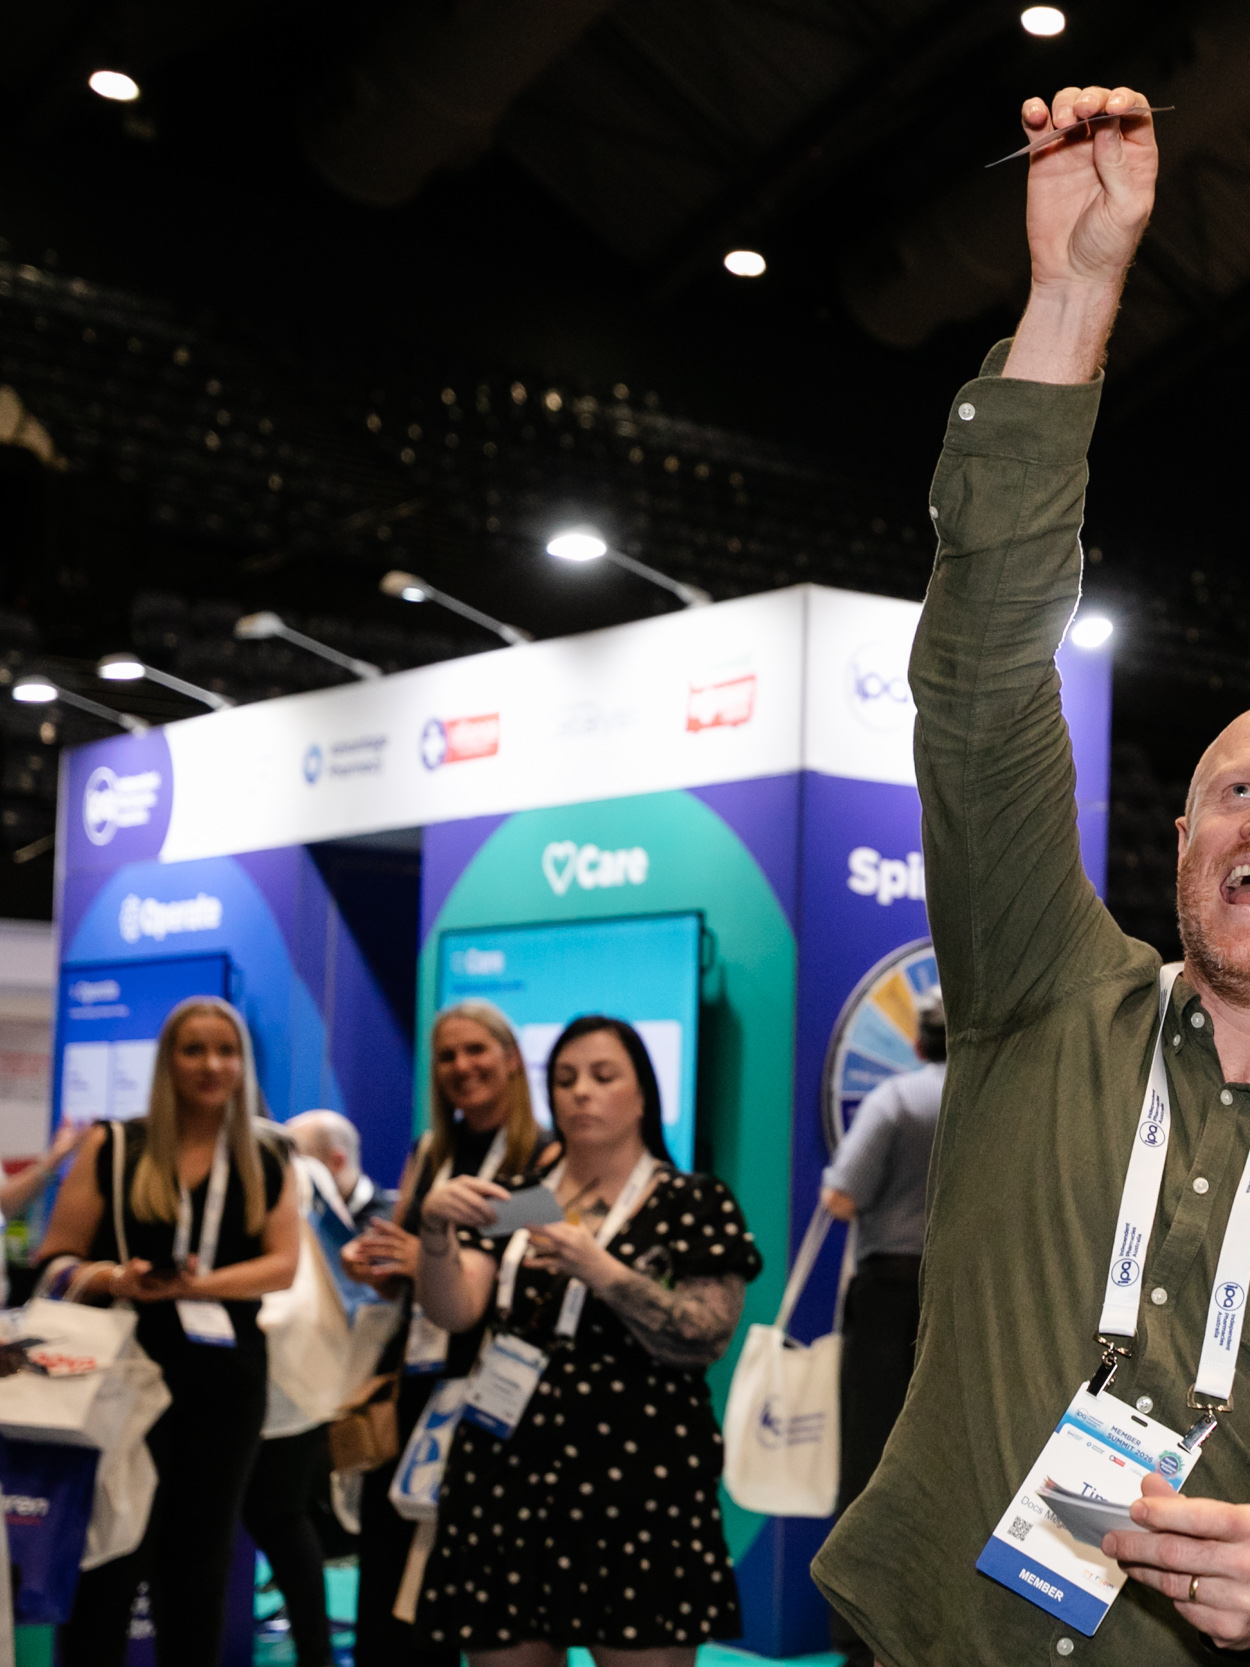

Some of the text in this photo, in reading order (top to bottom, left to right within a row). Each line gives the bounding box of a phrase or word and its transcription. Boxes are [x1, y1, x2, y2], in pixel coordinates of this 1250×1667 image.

[576, 843, 649, 890] Care
[848, 847, 926, 905] Spi
[1145, 1124, 1158, 1145] ipa
[1118, 1222, 1131, 1257] Independent
[1125, 1226, 1137, 1257] Pharmacies
[1132, 1233, 1142, 1258] Australia
[1117, 1261, 1132, 1284] ipa
[1222, 1284, 1239, 1308] ipa
[1213, 1310, 1223, 1339] Australia
[1218, 1312, 1230, 1347] Pharmacies
[1225, 1313, 1237, 1351] Independent
[1106, 1432, 1135, 1452] SUMMIT
[1135, 1449, 1154, 1464] 2026
[1110, 1425, 1142, 1447] MEMBER
[1020, 1496, 1067, 1531] Docs Meg
[1018, 1568, 1065, 1602] MEMBER
